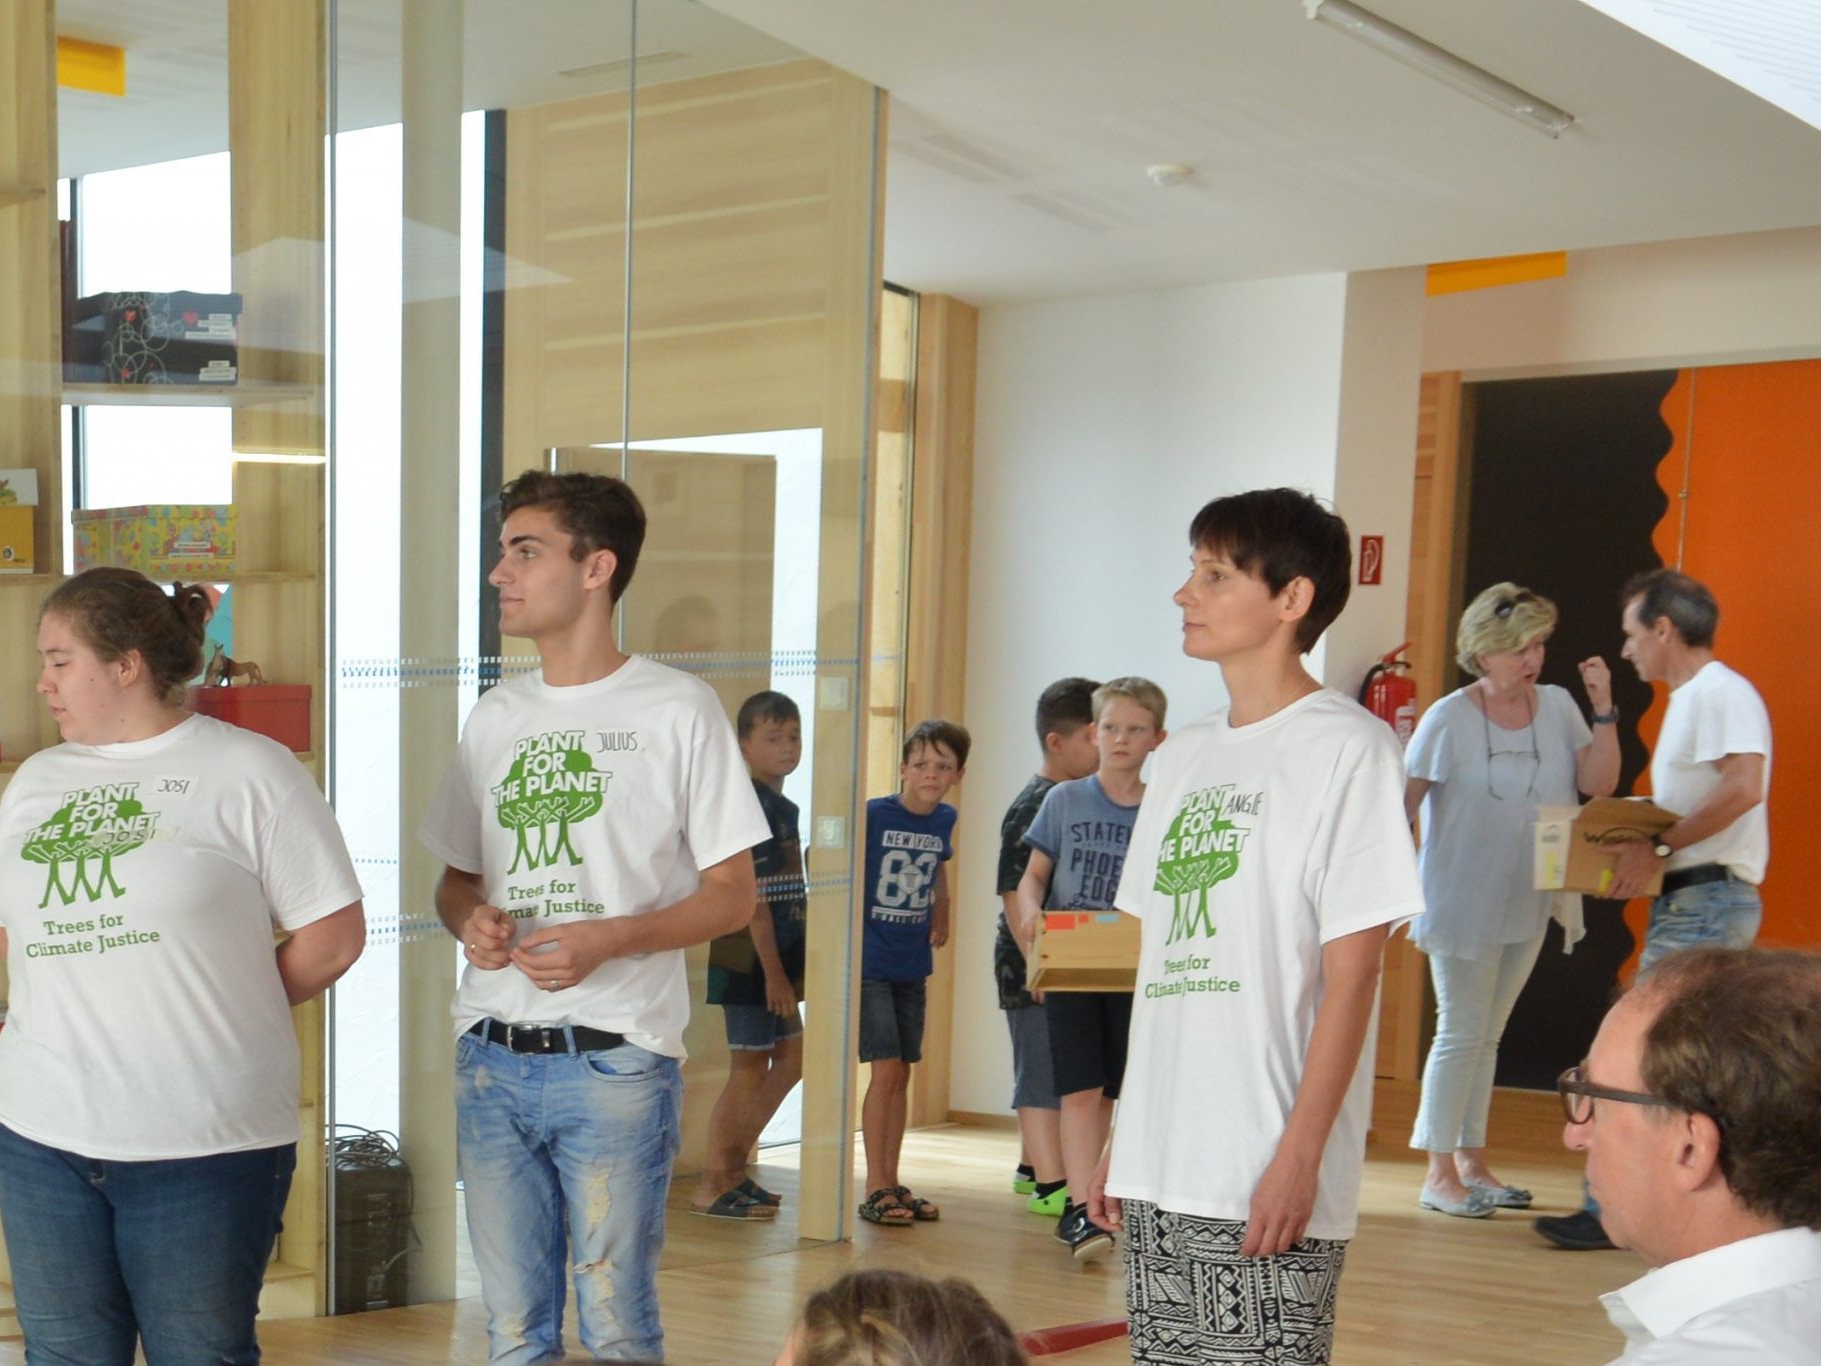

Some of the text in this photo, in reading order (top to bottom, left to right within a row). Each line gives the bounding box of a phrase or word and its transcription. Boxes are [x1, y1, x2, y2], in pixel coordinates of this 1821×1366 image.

[513, 730, 585, 760] PLANT
[596, 731, 638, 753] JULIUS
[523, 752, 567, 777] FOR
[62, 782, 140, 808] PLANT
[157, 778, 190, 795] JOSI
[491, 771, 613, 808] THE PLANET
[69, 802, 118, 823] FOR
[1179, 810, 1216, 837] FOR
[23, 812, 161, 844] THE PLANET
[103, 829, 156, 845] JOSI
[885, 831, 913, 847] NEW
[1159, 828, 1251, 863] HE PLANET
[550, 879, 576, 894] for
[544, 899, 605, 918] Justice
[43, 914, 124, 936] Trees for
[26, 930, 161, 958] Climate Justice
